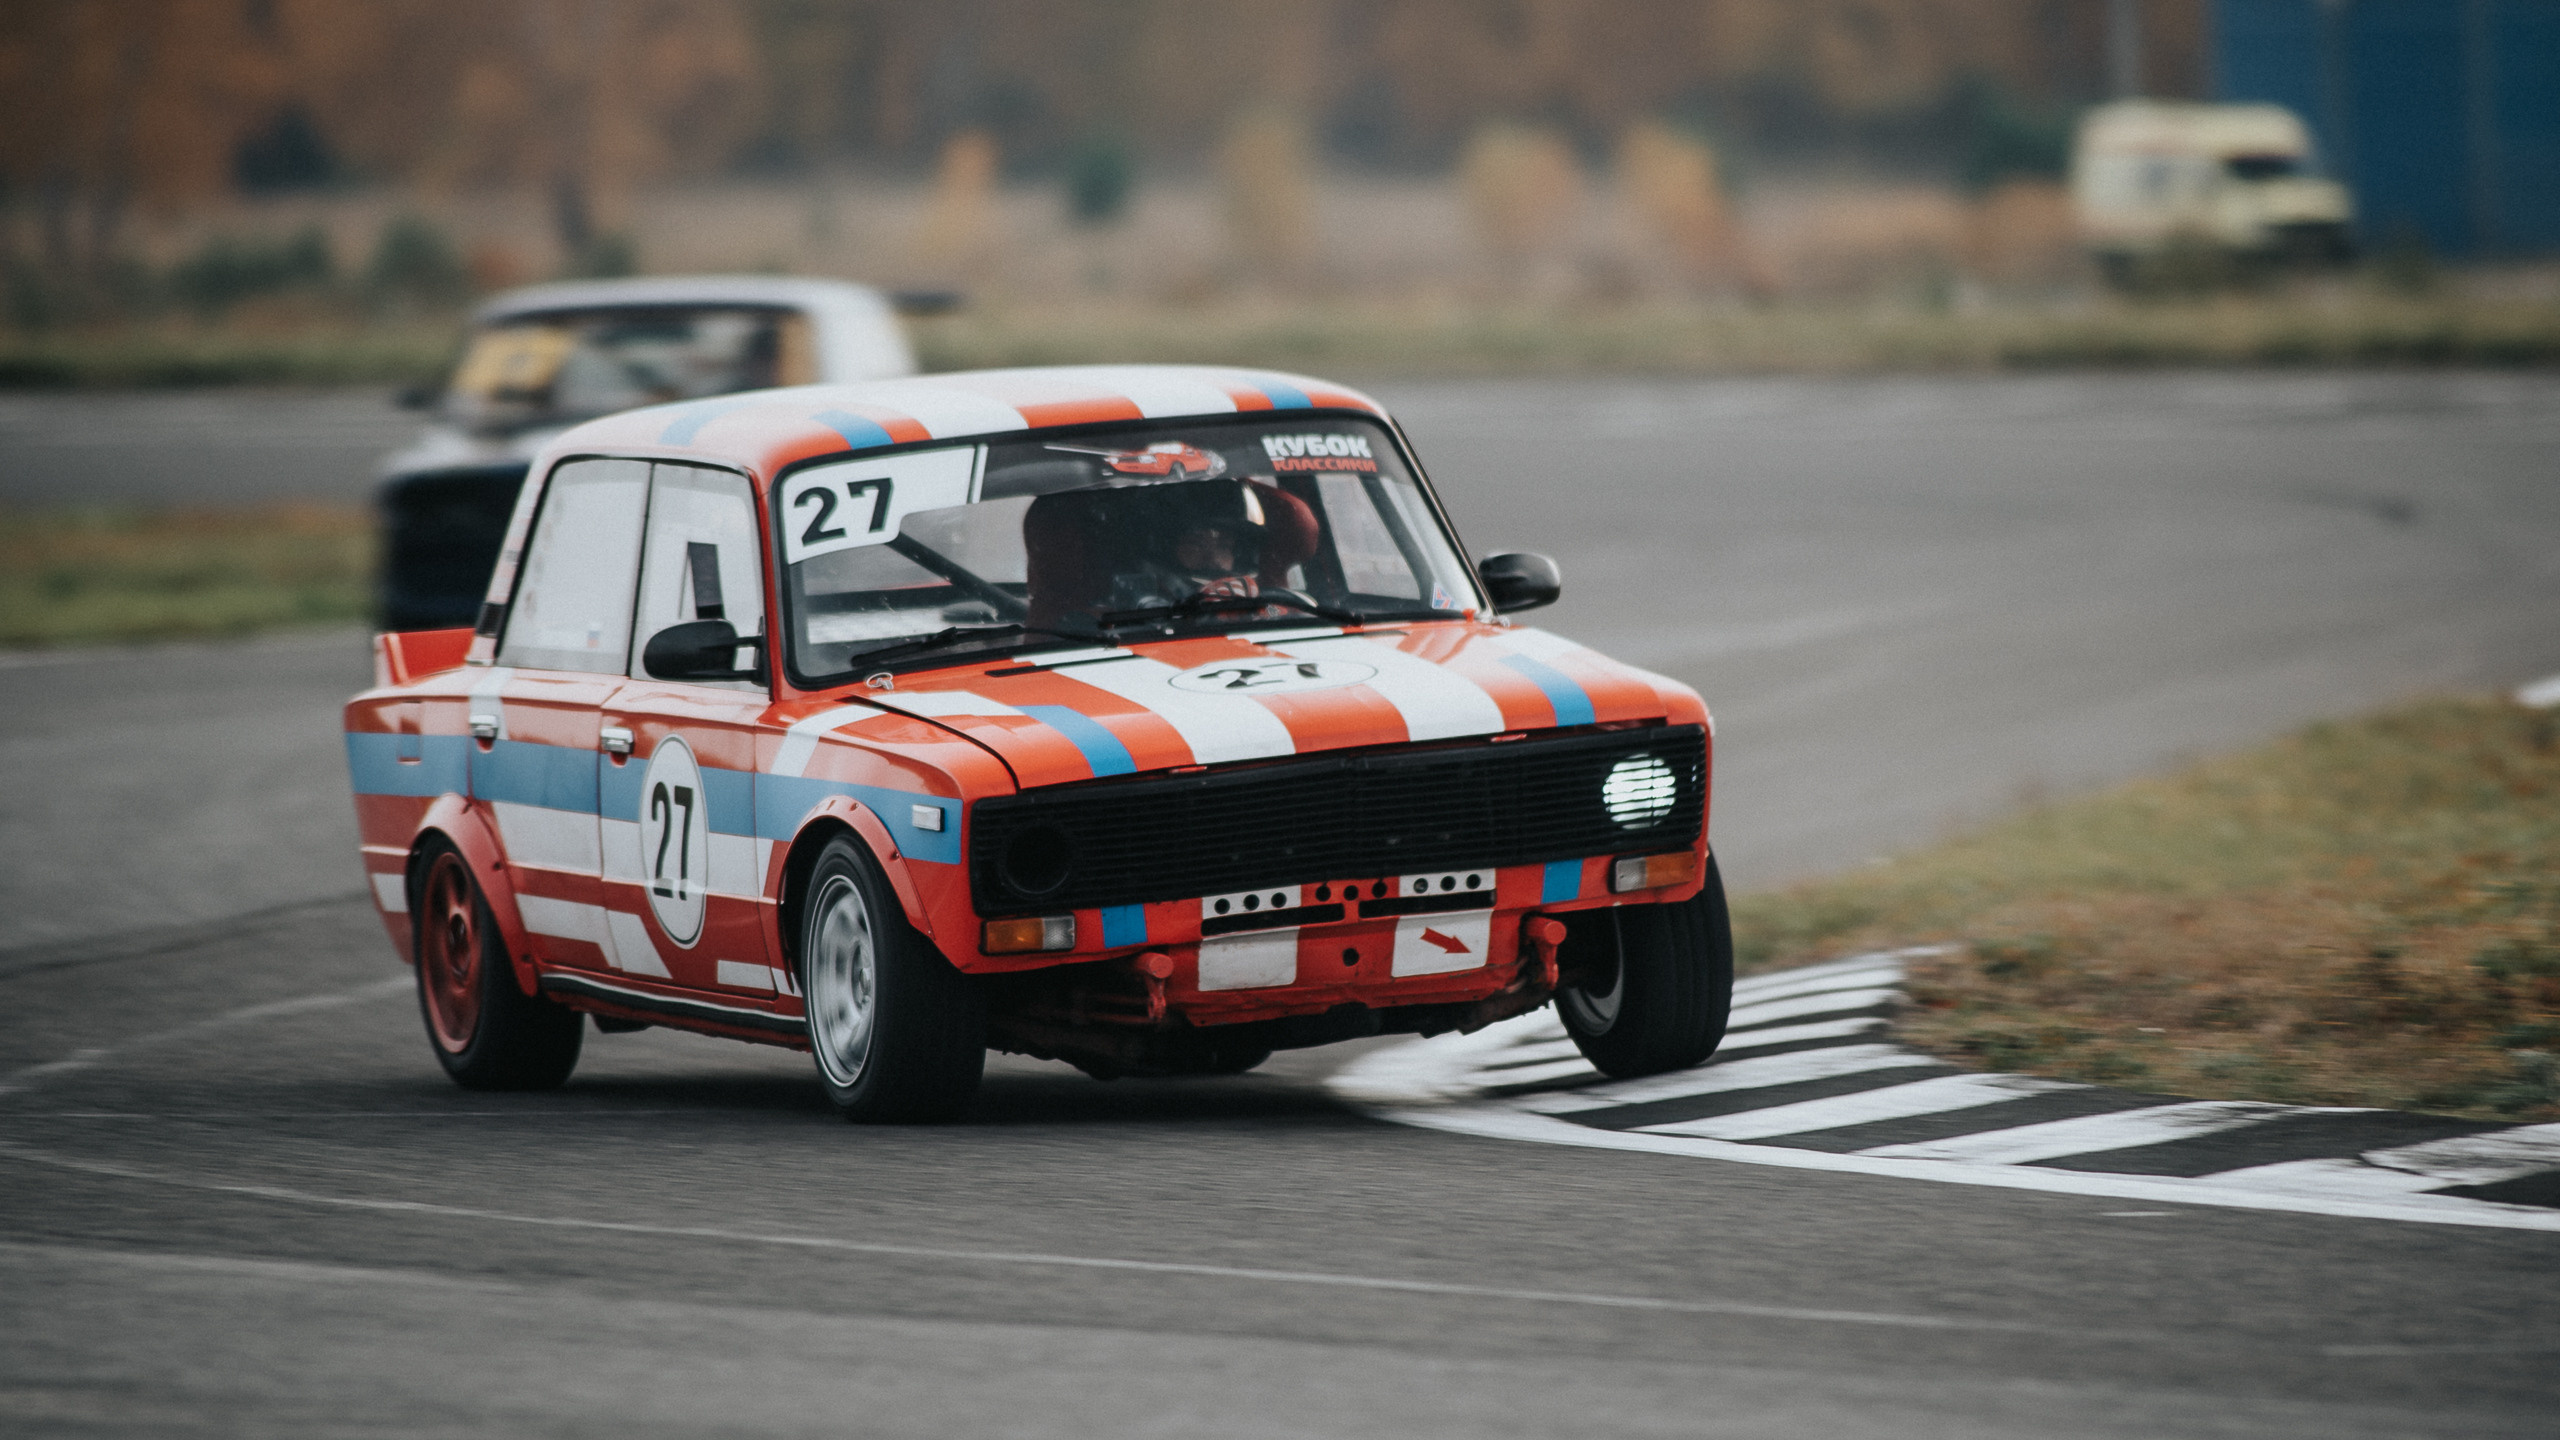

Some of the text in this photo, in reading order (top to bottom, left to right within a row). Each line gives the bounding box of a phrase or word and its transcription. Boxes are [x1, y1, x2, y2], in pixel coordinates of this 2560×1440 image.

[1261, 434, 1372, 461] КУБОК
[1272, 458, 1377, 472] КЛАССИКИ
[793, 477, 895, 547] 27
[1197, 662, 1322, 689] 27
[651, 782, 694, 901] 27
